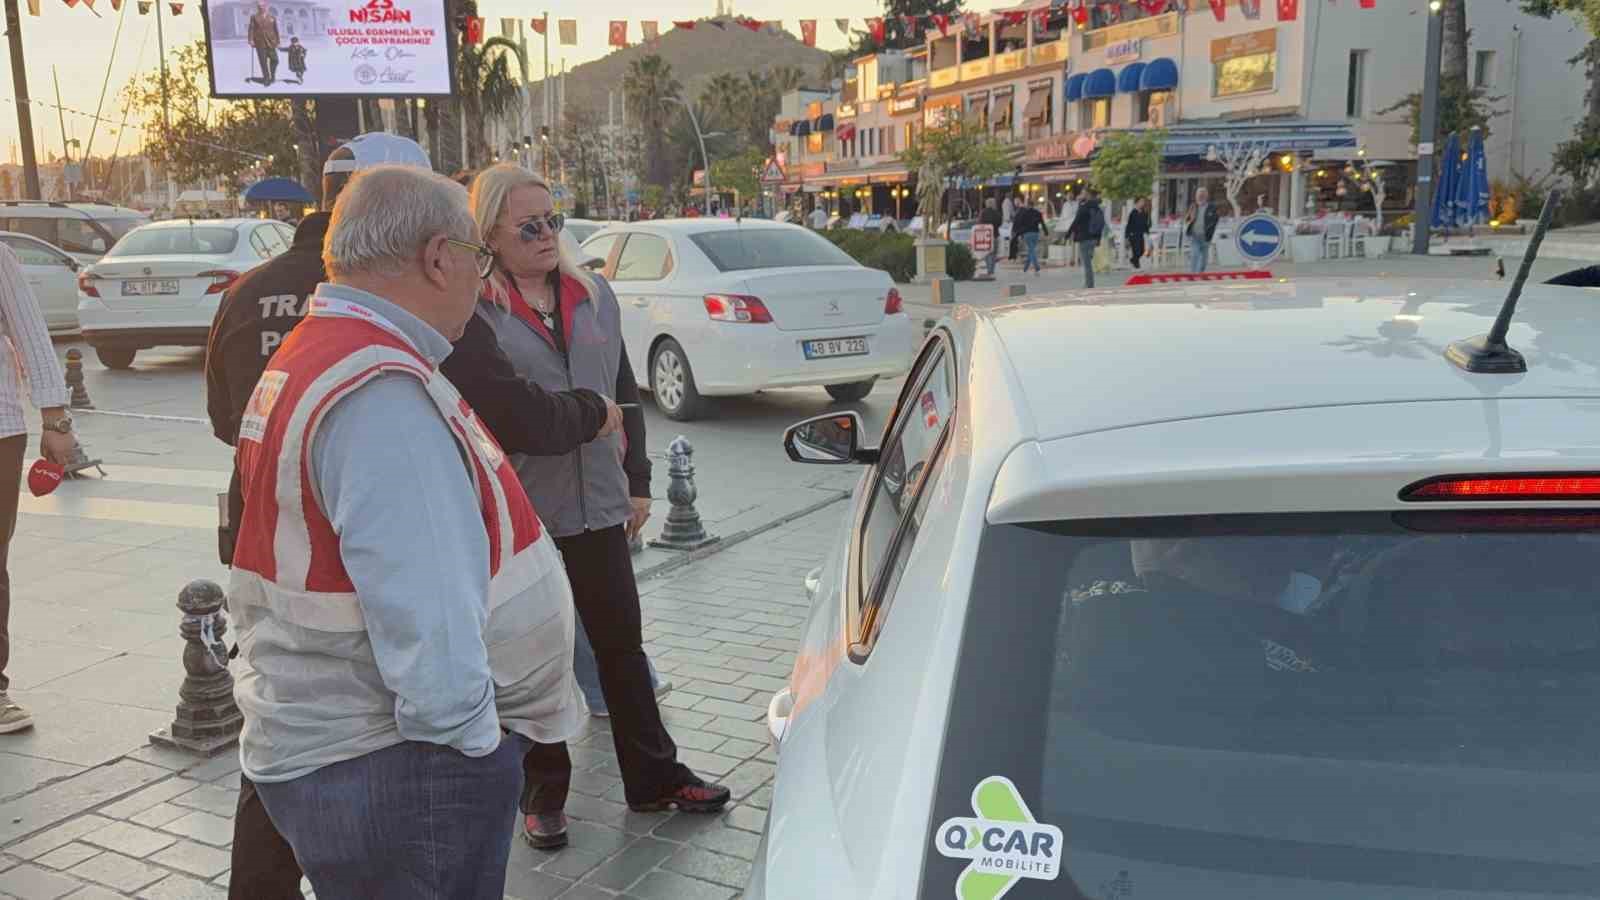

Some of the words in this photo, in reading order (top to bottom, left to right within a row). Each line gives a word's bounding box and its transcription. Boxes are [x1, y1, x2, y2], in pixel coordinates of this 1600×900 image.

[328, 28, 364, 36] ULUSAL
[366, 26, 420, 36] EGEMENLİK
[423, 29, 435, 37] VE
[335, 37, 370, 46] ÇOCUK
[371, 37, 431, 45] BAYRAMIMIZ
[975, 230, 990, 241] WC
[261, 330, 291, 356] P
[811, 343, 824, 354] 48
[828, 341, 841, 353] BV
[846, 339, 865, 352] 229
